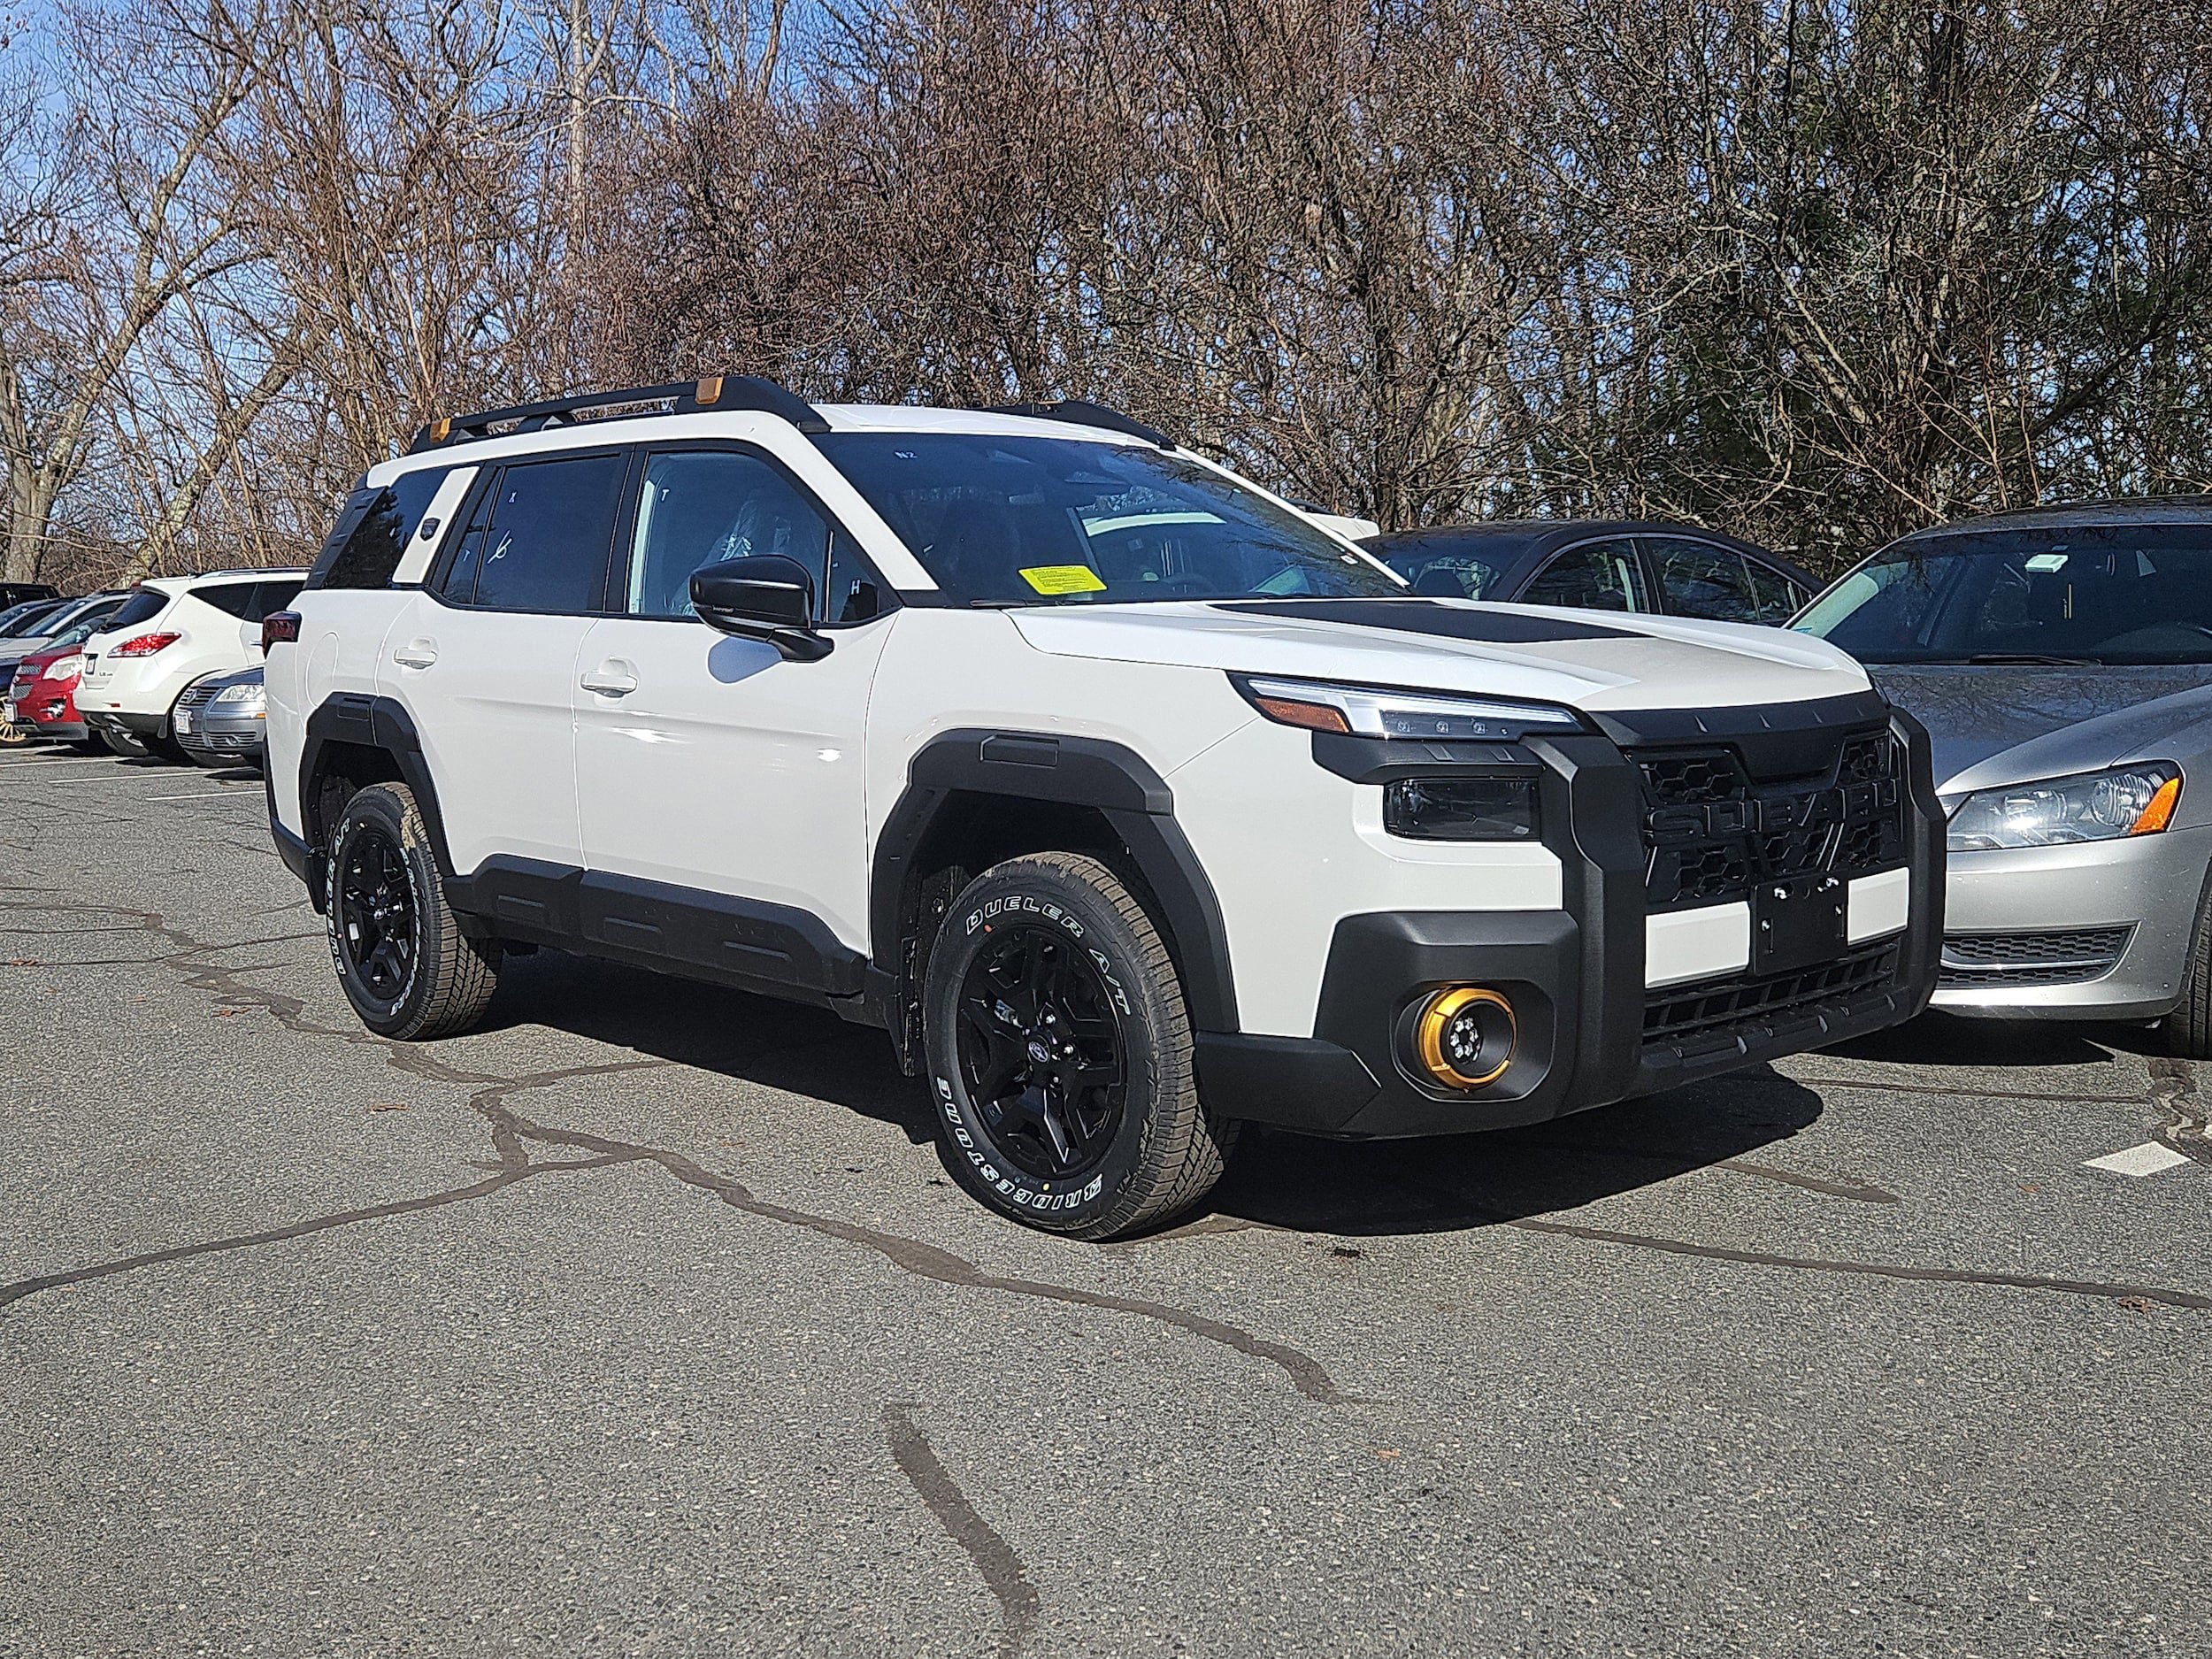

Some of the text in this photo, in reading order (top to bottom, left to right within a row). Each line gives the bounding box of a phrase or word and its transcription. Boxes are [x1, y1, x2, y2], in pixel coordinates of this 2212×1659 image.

[850, 579, 861, 595] H
[326, 857, 347, 975] DUELER
[966, 895, 1132, 1016] DUELER A/T
[936, 1076, 1103, 1211] BRIDGESTONE
